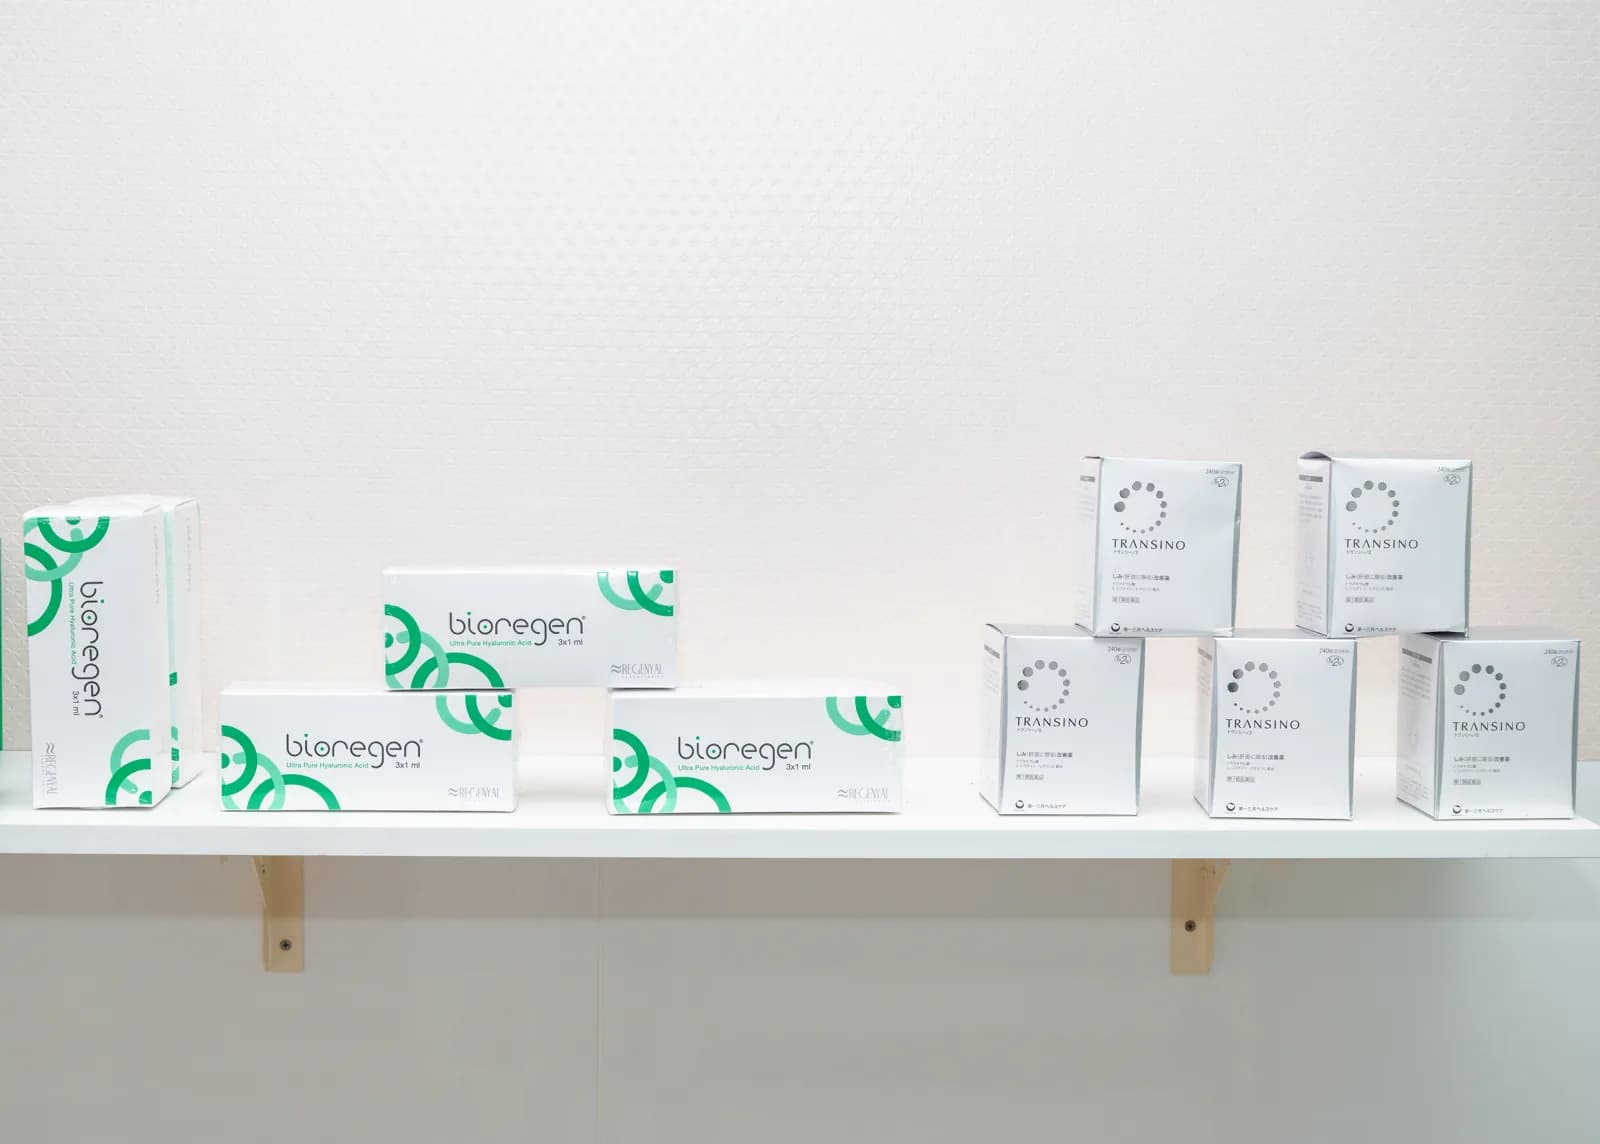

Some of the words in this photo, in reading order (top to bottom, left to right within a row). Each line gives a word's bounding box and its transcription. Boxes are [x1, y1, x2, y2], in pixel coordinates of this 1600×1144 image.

[1112, 538, 1186, 551] TRANSINO
[1344, 538, 1419, 550] TRANSINO
[68, 599, 76, 613] Pure
[449, 611, 584, 646] bioregen
[72, 581, 104, 716] bioregen
[482, 640, 513, 648] Hyaluronic
[70, 650, 78, 665] Acid
[72, 690, 80, 704] 3x1
[1016, 716, 1089, 728] TRANSINO
[1226, 719, 1300, 730] TRANSINO
[1453, 721, 1526, 732] TRANSINO
[286, 733, 421, 769] bioregen
[678, 736, 812, 771] bioregen
[319, 762, 353, 770] Hyaluronic
[395, 761, 409, 769] 3x1
[411, 761, 420, 769] ml
[711, 764, 743, 772] Hyaluronic
[785, 763, 800, 771] 3x1
[801, 763, 811, 771] ml
